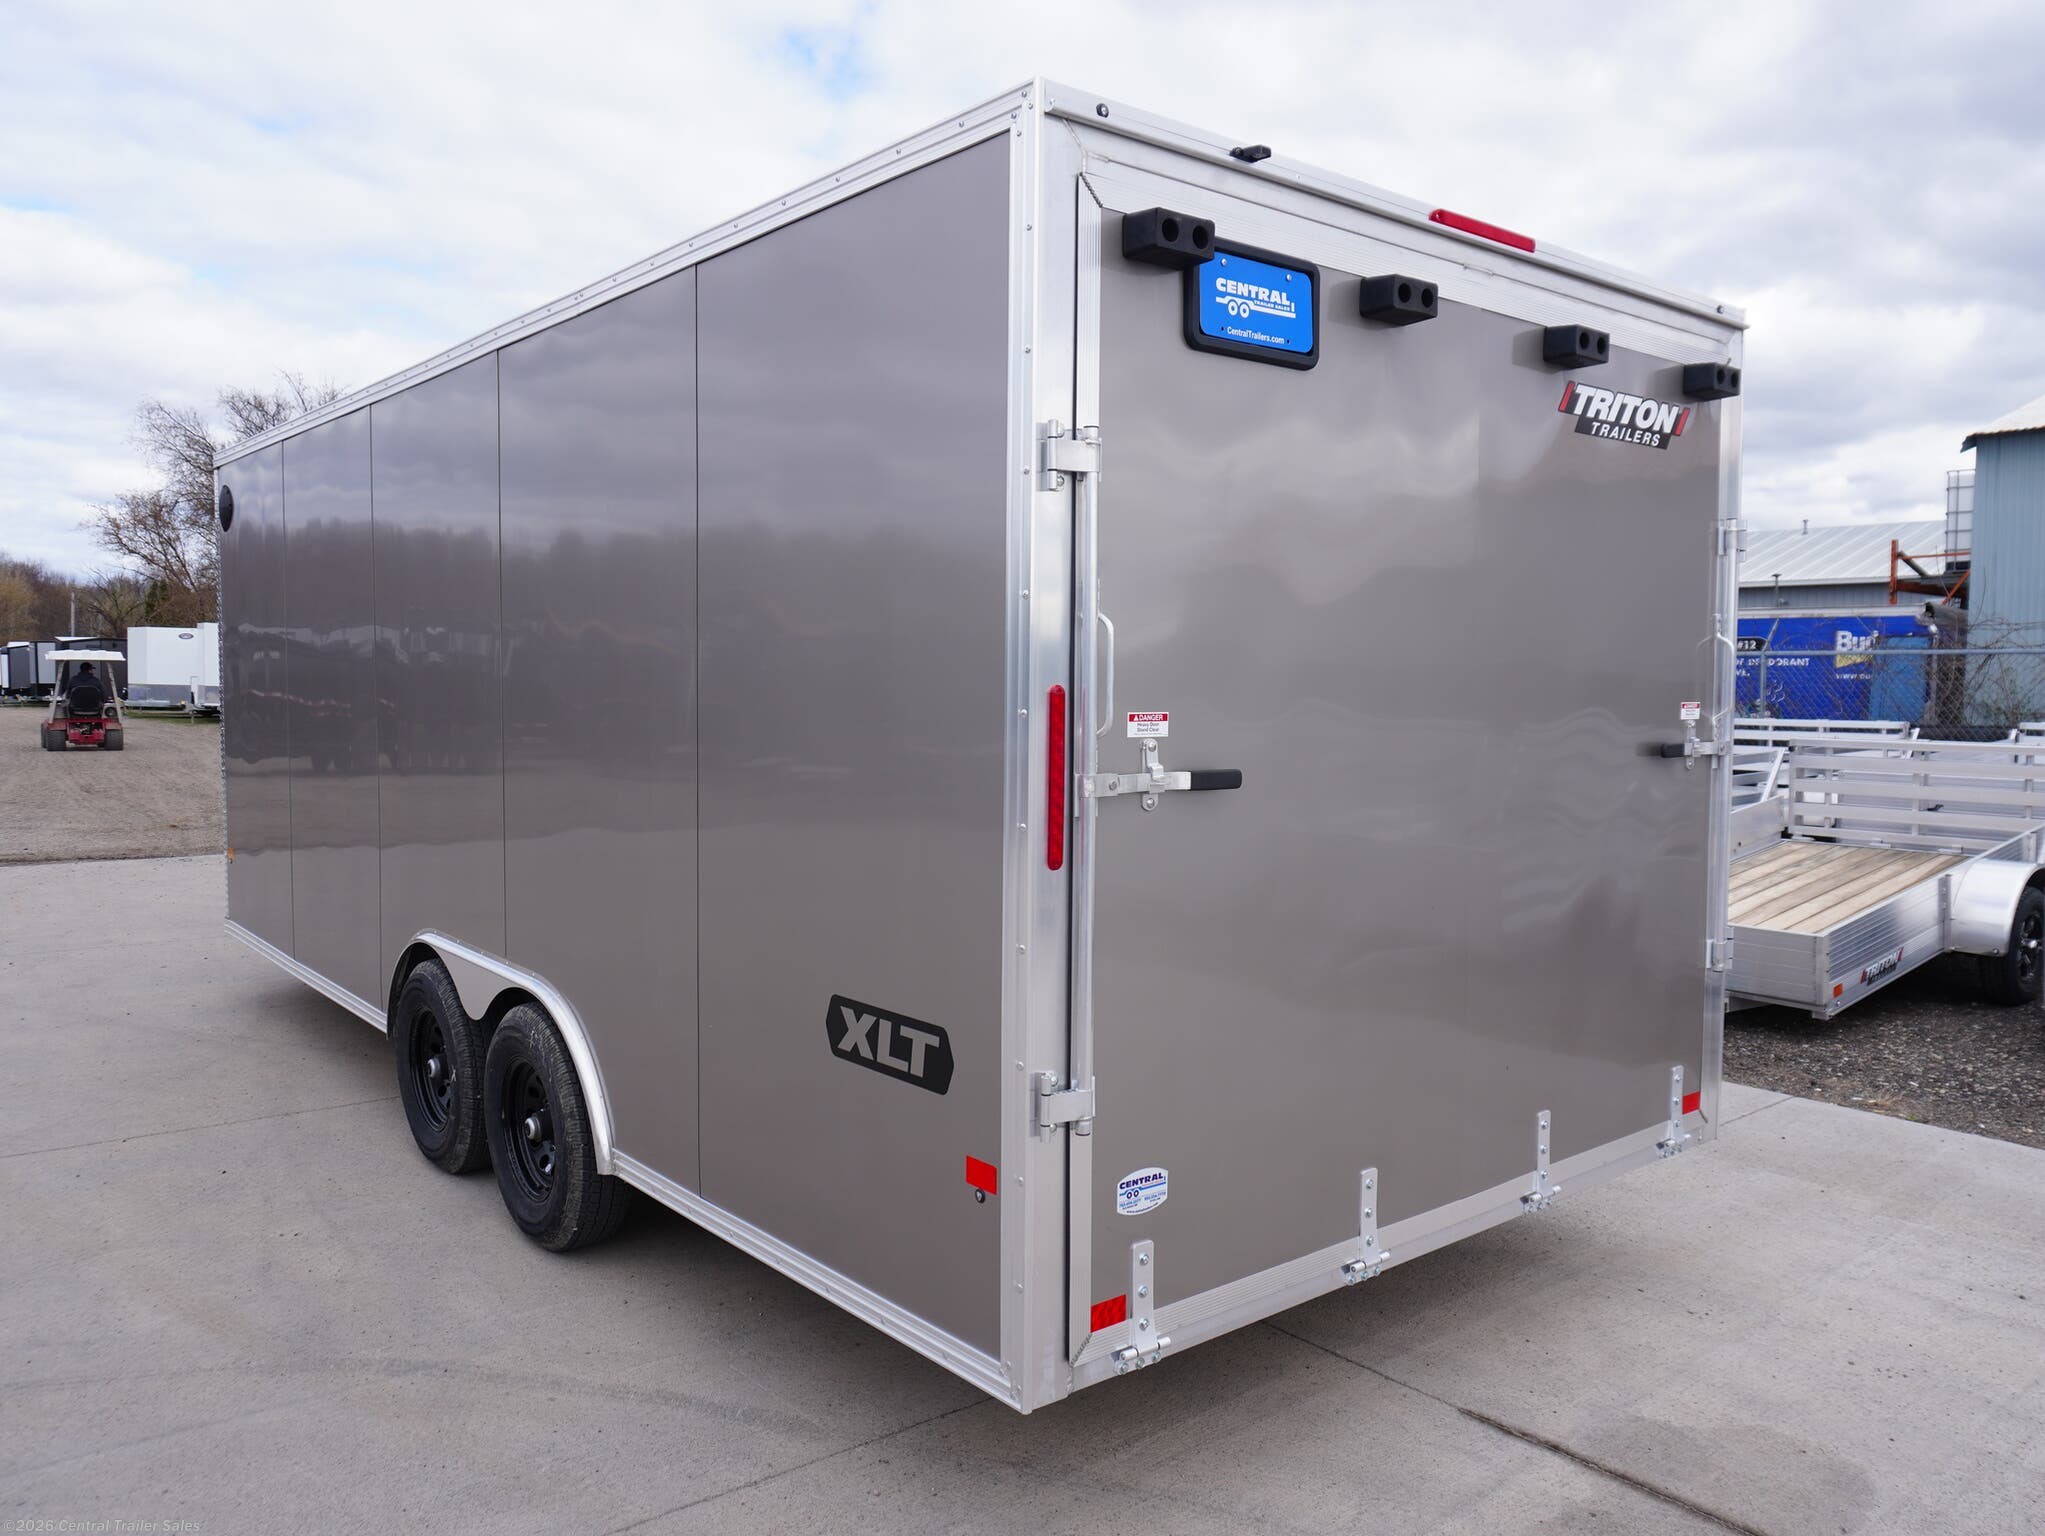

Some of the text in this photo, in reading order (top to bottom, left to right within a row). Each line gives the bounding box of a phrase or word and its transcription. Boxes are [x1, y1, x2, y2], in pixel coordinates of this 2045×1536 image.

[1216, 277, 1290, 306] CENTRAL
[1227, 326, 1285, 345] CentralTrailers.com
[1573, 384, 1680, 433] TRITON
[1591, 422, 1661, 447] TRAILERS
[837, 1005, 940, 1078] XLT
[1120, 1172, 1163, 1190] CENTRAL
